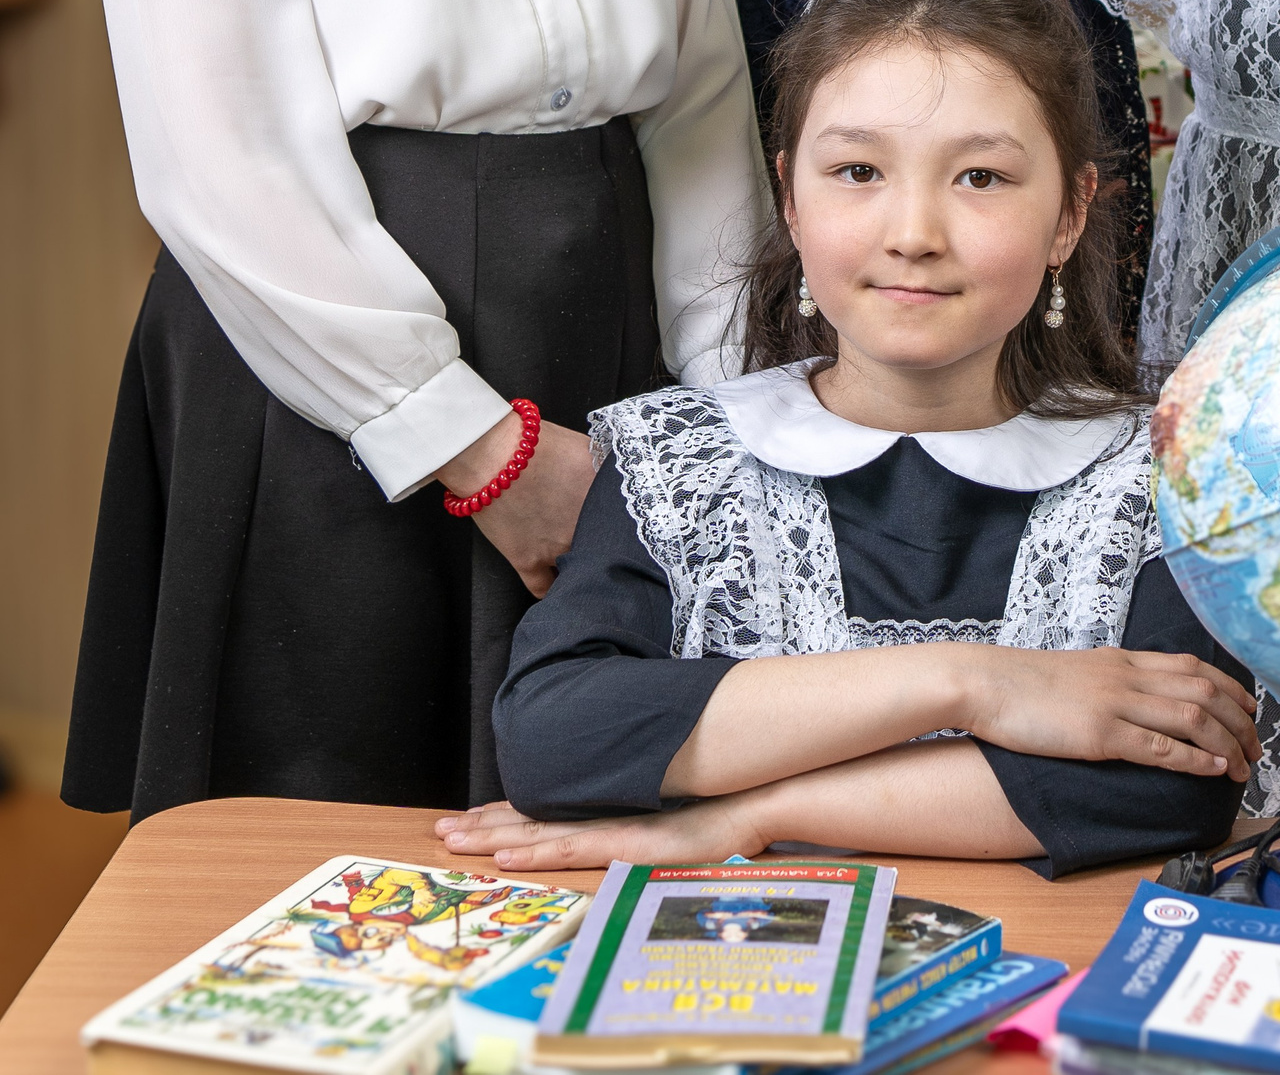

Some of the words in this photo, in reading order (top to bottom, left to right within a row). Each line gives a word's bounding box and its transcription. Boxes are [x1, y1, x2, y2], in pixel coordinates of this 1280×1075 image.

[658, 869, 712, 878] школы
[719, 869, 808, 878] начальной
[817, 867, 849, 877] для
[700, 886, 761, 895] классы
[622, 979, 819, 995] МАТЕМАТИКА
[672, 992, 755, 1012] ВСЯ
